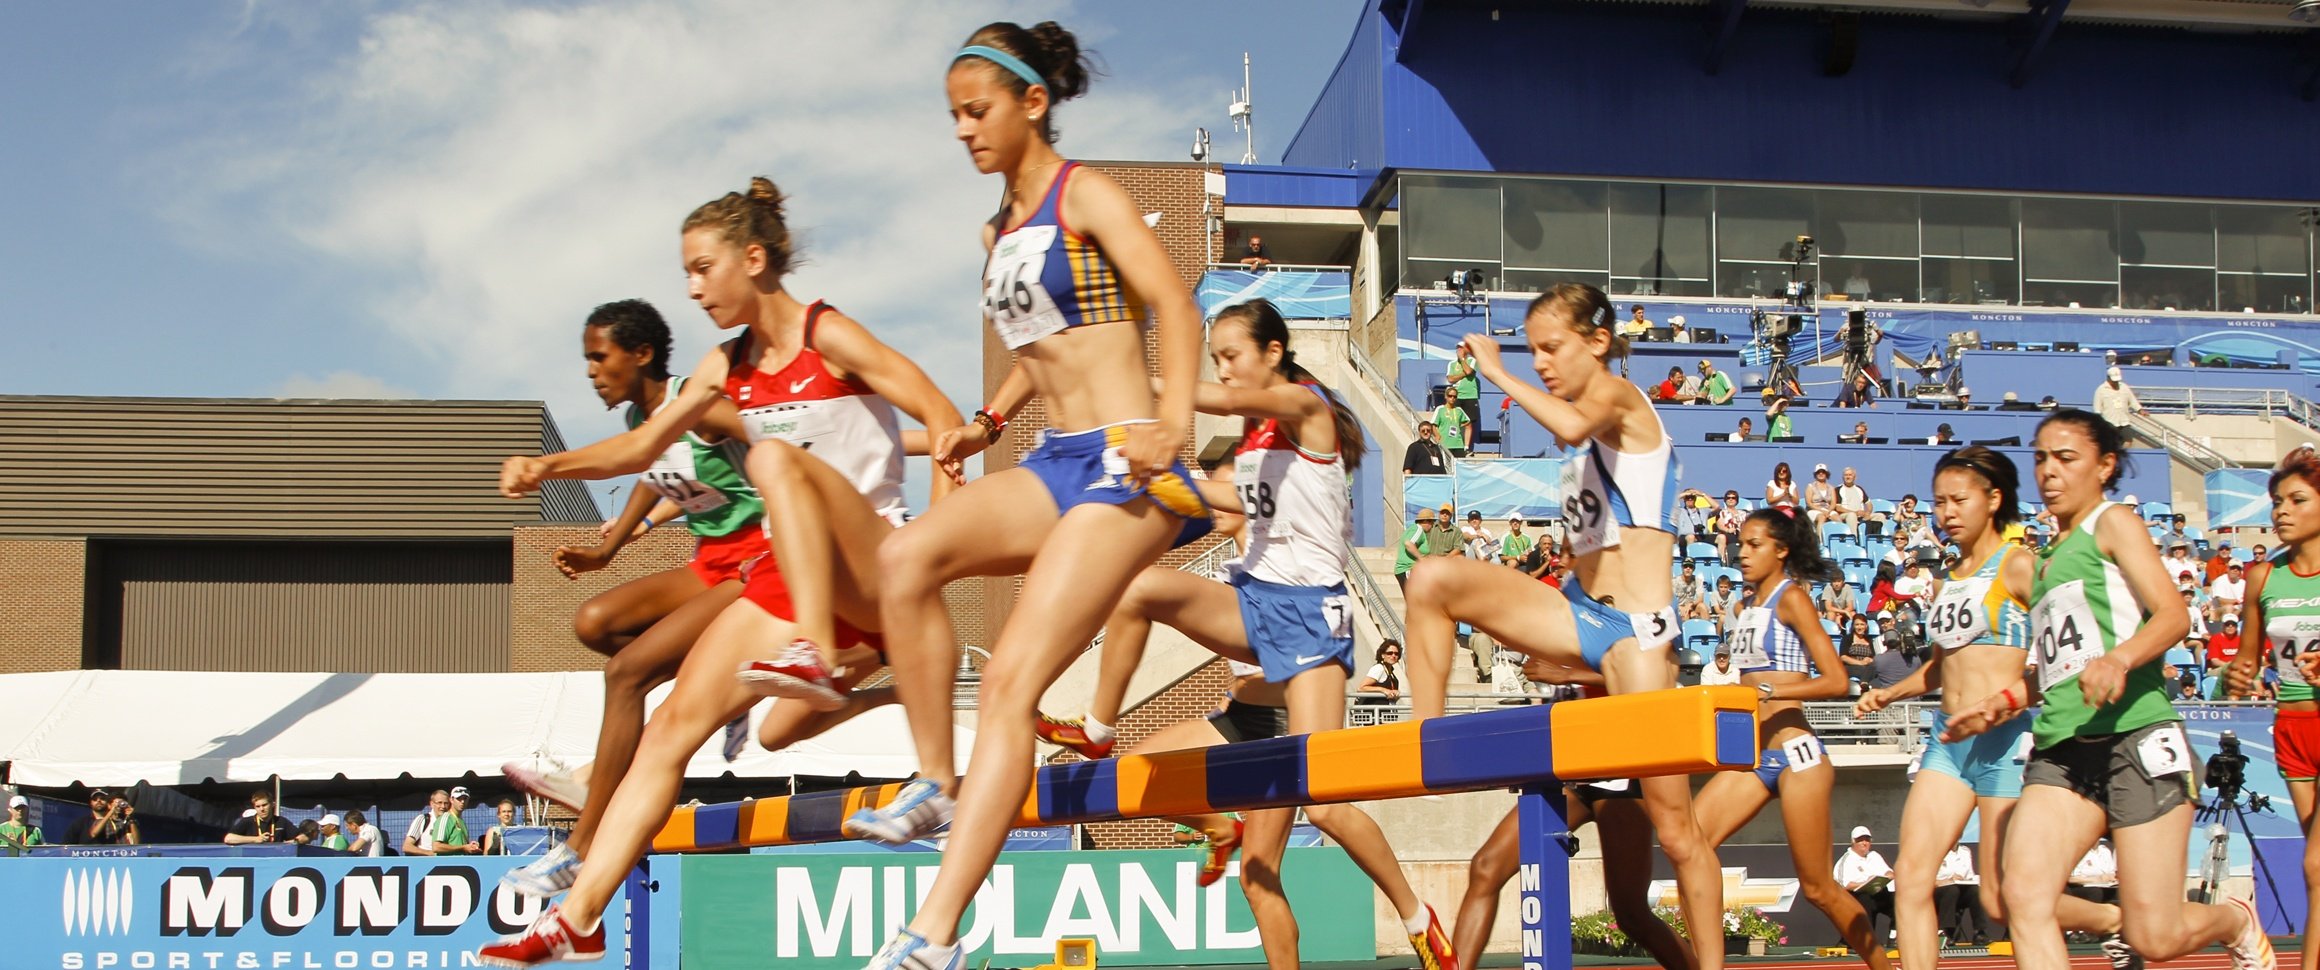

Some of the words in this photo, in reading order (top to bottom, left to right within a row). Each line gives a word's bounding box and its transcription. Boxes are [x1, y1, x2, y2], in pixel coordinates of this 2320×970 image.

[1841, 310, 1893, 318] MCTON
[1971, 314, 2023, 322] MONCTON
[2226, 320, 2276, 328] MONCTON
[1930, 598, 1974, 634] 436
[1793, 741, 1813, 764] 11
[71, 849, 139, 858] MONCTON
[160, 866, 550, 937] MONDO
[62, 951, 485, 969] SPORT&FLOORIN
